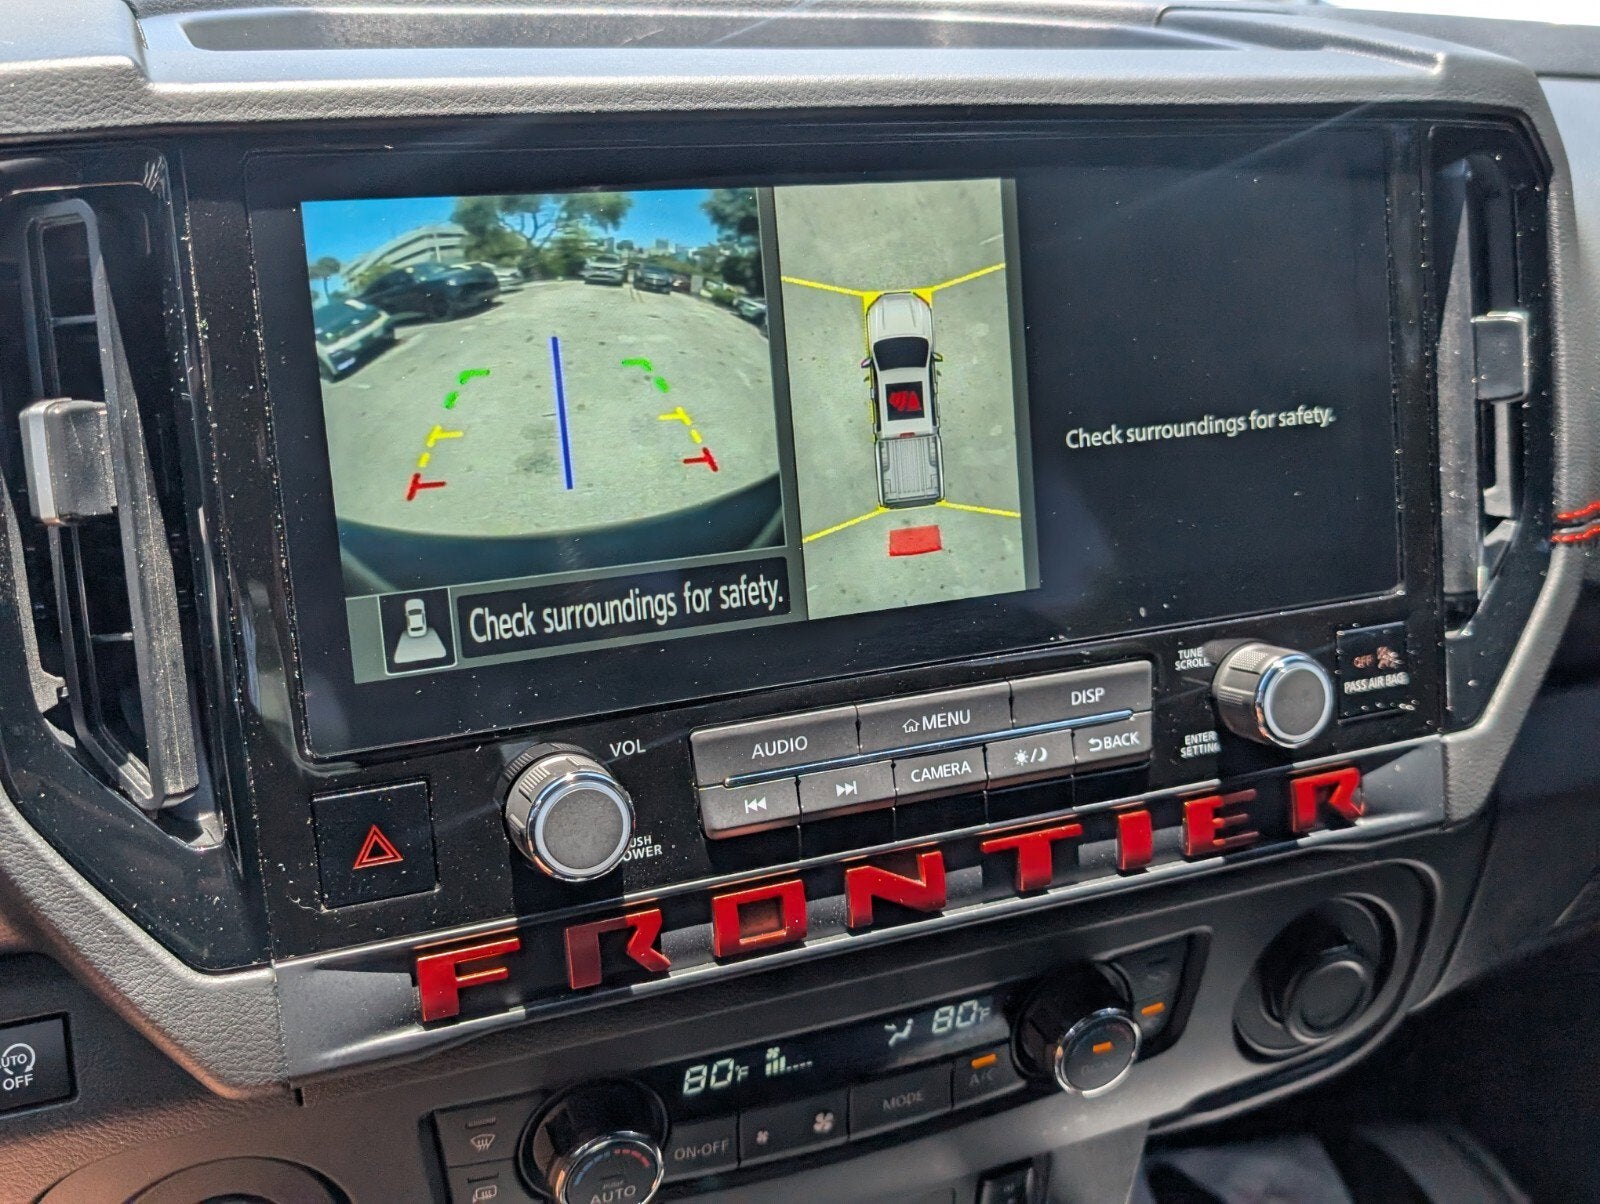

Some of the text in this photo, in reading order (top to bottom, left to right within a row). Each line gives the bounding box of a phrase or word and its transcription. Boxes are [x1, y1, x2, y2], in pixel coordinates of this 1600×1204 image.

[1065, 404, 1337, 449] Check surroundings for safety.
[469, 573, 784, 644] Check surroundings for safety.
[1177, 646, 1204, 660] TUNE
[1174, 657, 1211, 672] SCROLL
[1343, 678, 1370, 695] PASS
[1368, 675, 1386, 690] AIR
[1071, 687, 1105, 705] DISP
[922, 708, 973, 733] MENU
[751, 735, 808, 760] AUDIO
[1103, 730, 1141, 749] BACK
[1184, 730, 1218, 746] ENTER
[609, 739, 646, 758] VOL
[910, 760, 973, 784] CAMERA
[3, 1073, 34, 1091] OFF
[882, 1090, 925, 1112] MODE
[589, 1184, 637, 1204] AUTO
